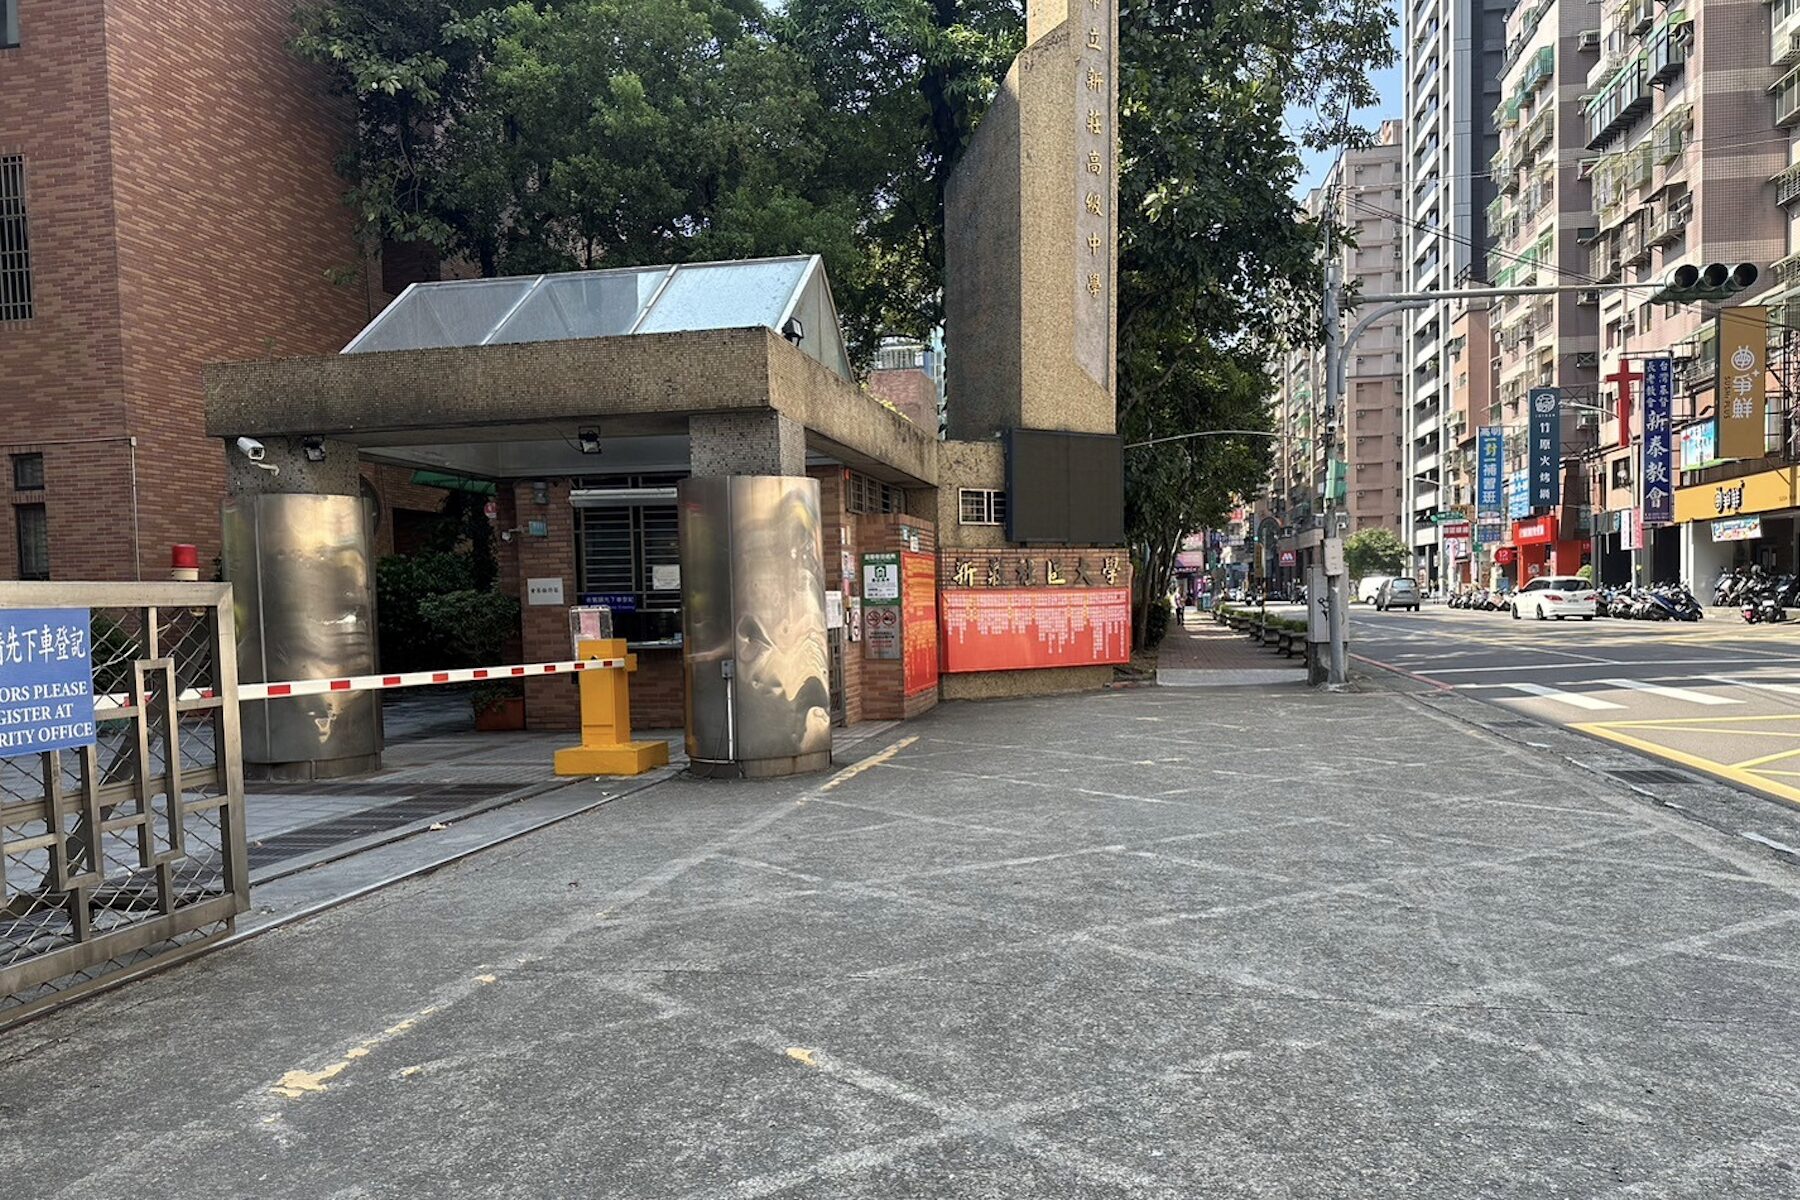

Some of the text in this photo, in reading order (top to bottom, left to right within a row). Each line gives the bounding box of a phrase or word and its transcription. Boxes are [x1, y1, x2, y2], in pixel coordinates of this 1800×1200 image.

[1645, 410, 1669, 508] 新泰教會
[34, 681, 88, 700] PLEASE
[55, 703, 73, 719] AT
[38, 722, 93, 743] OFFICE
